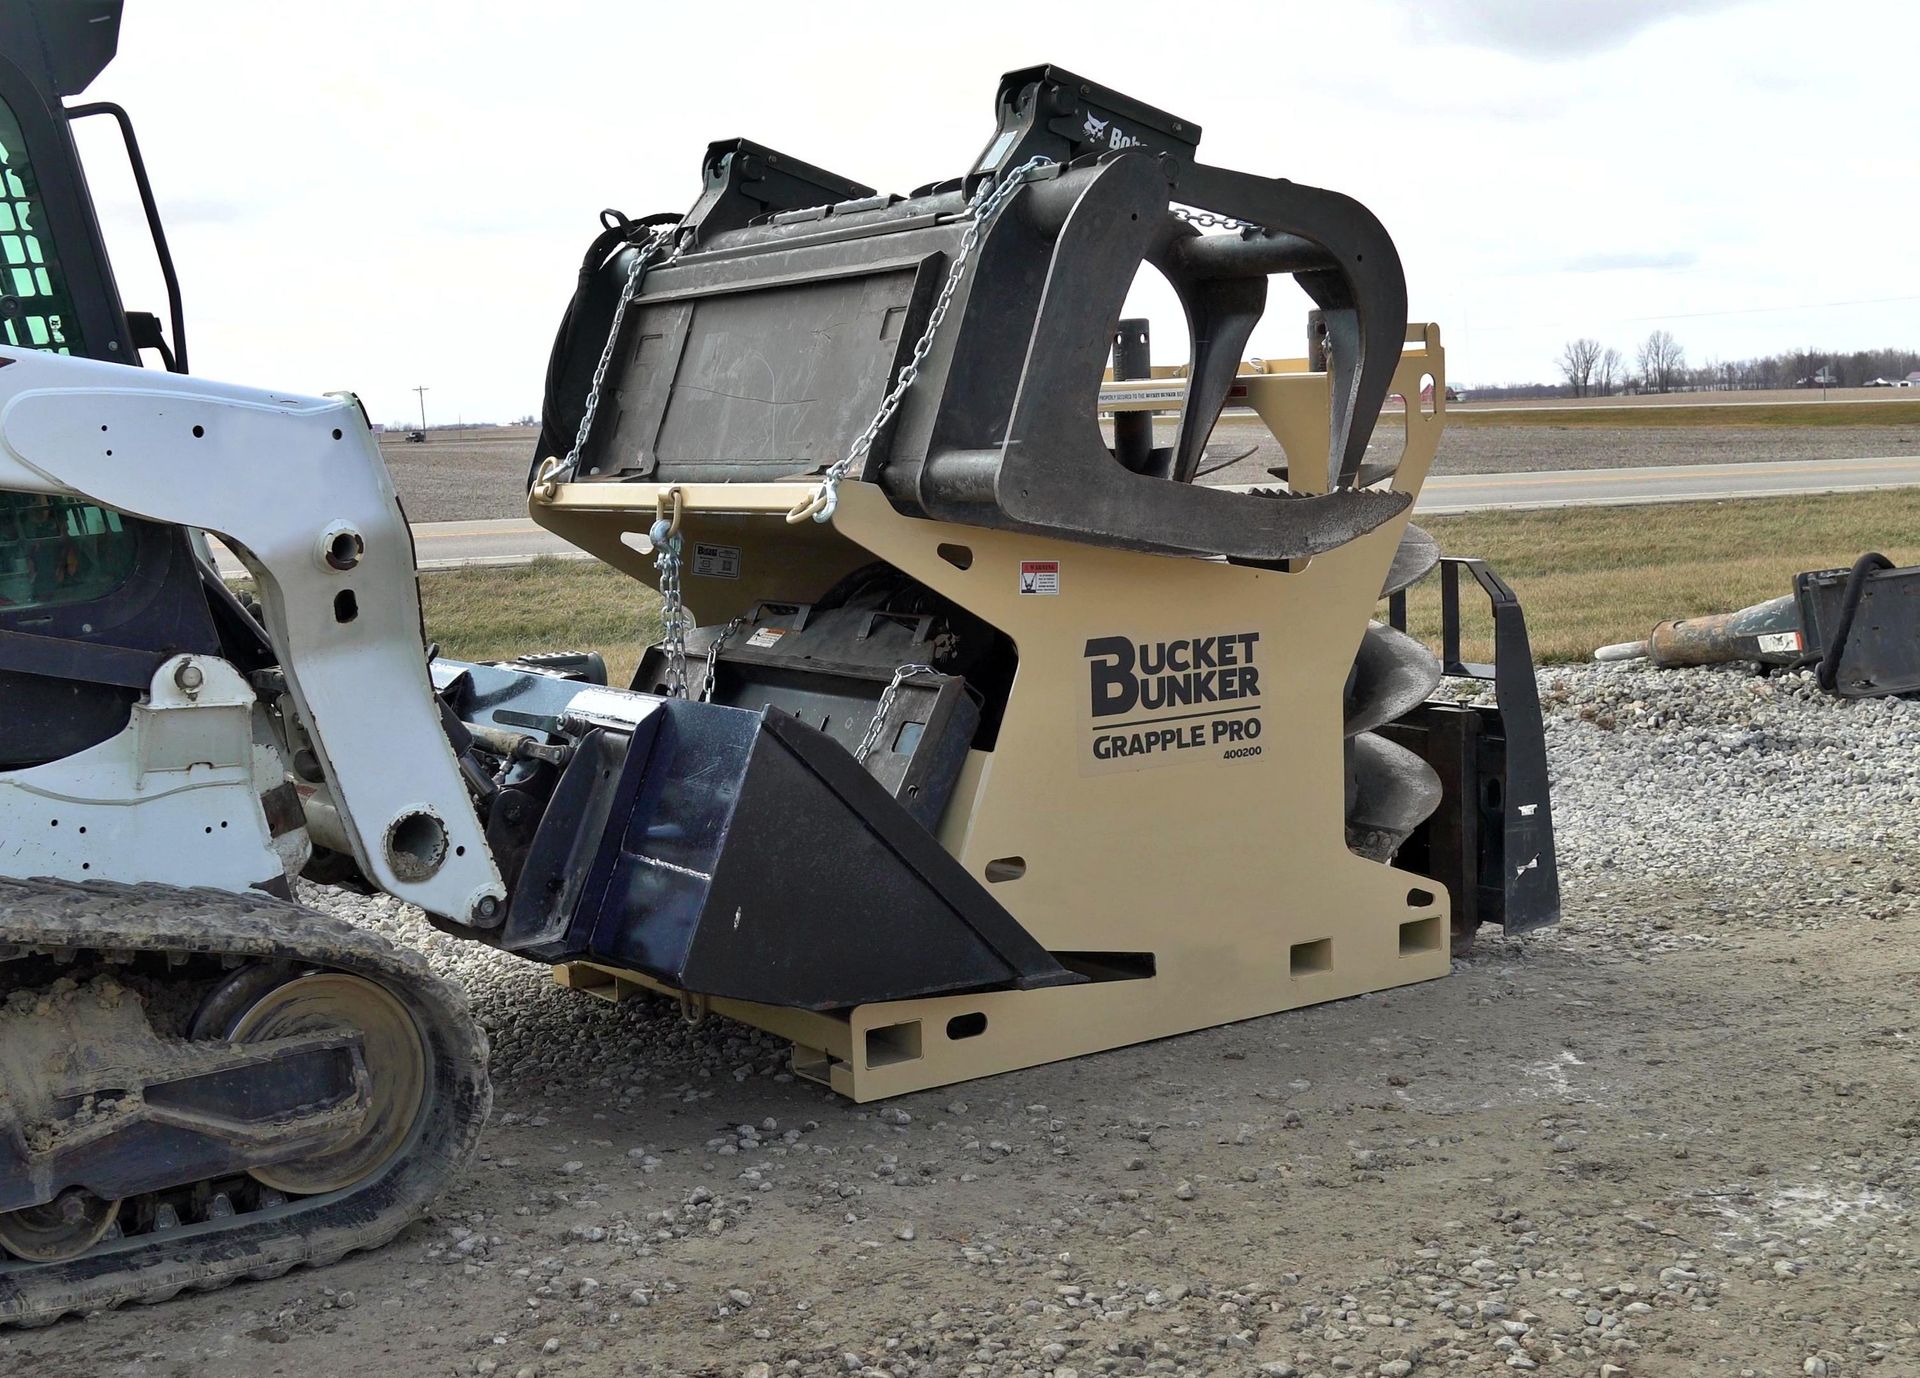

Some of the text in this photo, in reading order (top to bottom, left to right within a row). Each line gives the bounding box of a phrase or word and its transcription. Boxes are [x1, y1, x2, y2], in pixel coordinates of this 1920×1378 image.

[1084, 632, 1259, 717] BUCKET
[1093, 717, 1262, 760] GRAPPLE PRO
[1223, 746, 1262, 760] 400200
